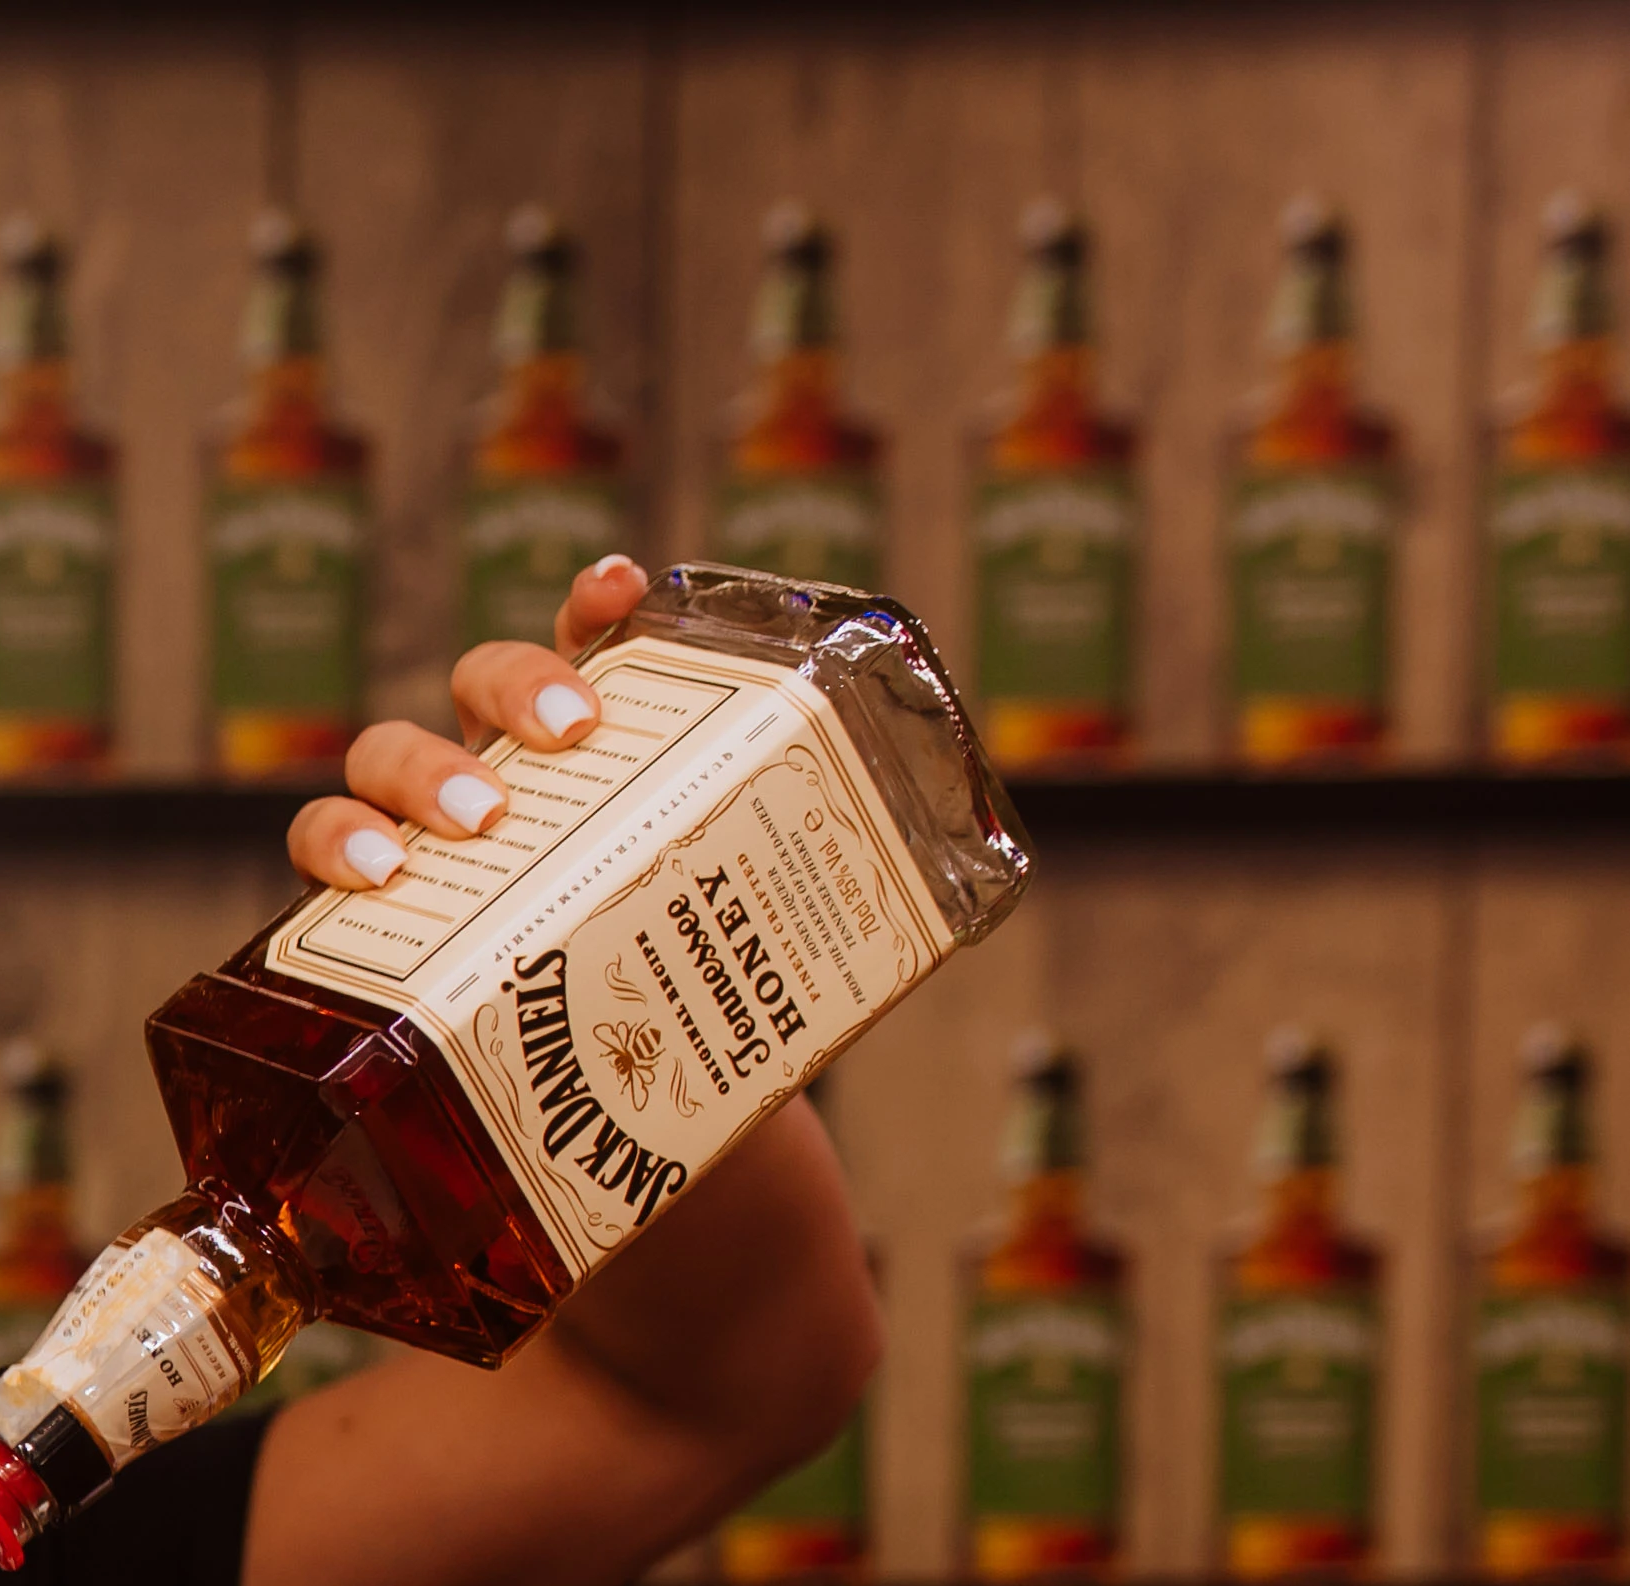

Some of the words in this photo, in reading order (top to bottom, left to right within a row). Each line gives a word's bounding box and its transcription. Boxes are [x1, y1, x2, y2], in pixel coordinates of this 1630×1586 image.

[599, 689, 653, 708] CHILLED
[649, 700, 690, 716] ENJOY
[655, 750, 735, 818] QUALITY
[640, 819, 655, 831] &
[750, 797, 783, 848] DANIEL'S
[777, 848, 802, 878] JACK
[788, 830, 820, 884] WHISKEY
[819, 833, 843, 872] Vol.
[489, 833, 639, 963] CRAFTSMANSHIP
[737, 853, 783, 935] CRAFTED
[767, 866, 799, 919] LIQUEUR
[792, 877, 807, 895] OF
[832, 864, 862, 905] 35%
[334, 916, 380, 934] FLAVOR
[377, 929, 426, 948] MELLOW
[793, 920, 822, 961] HONEY
[802, 895, 830, 944] MAKERS
[816, 882, 856, 950] TENNESSEE
[851, 900, 881, 942] 70cl
[634, 930, 680, 1004] RECIPE
[694, 865, 807, 1046] HONEY
[781, 938, 821, 1003] FINELY
[829, 943, 847, 971] THE
[667, 894, 770, 1078] Tennessee
[842, 971, 866, 1005] FROM
[500, 949, 604, 1161] DANIEL'S
[675, 1003, 730, 1095] ORIGINAL
[574, 1114, 688, 1227] JACK
[132, 1327, 183, 1388] HONE
